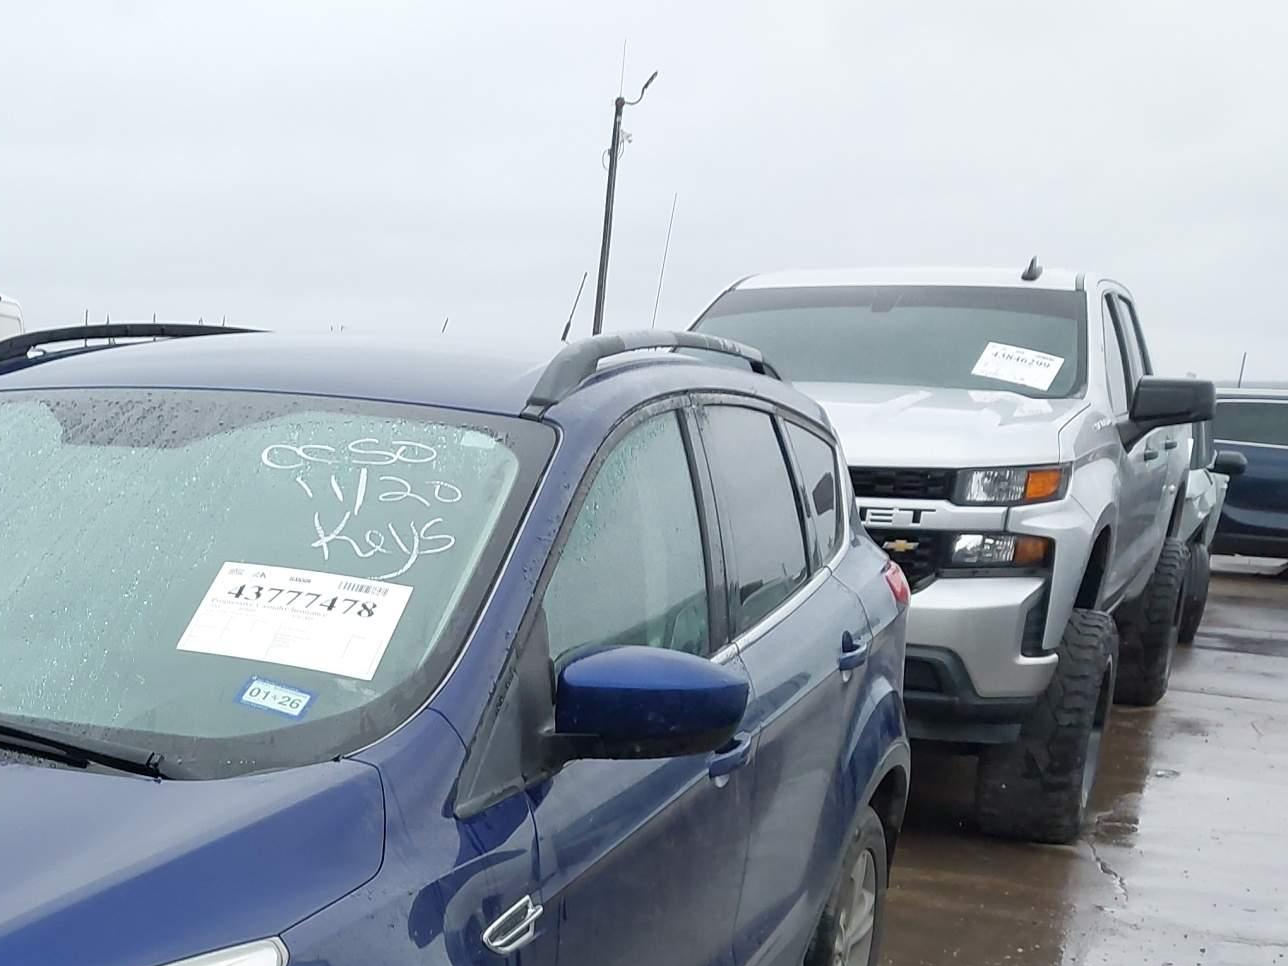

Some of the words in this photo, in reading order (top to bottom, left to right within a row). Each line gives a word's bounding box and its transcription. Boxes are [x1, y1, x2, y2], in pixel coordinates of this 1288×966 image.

[296, 467, 462, 516] 11/20
[311, 511, 456, 580] Keys
[226, 584, 378, 619] 43777478
